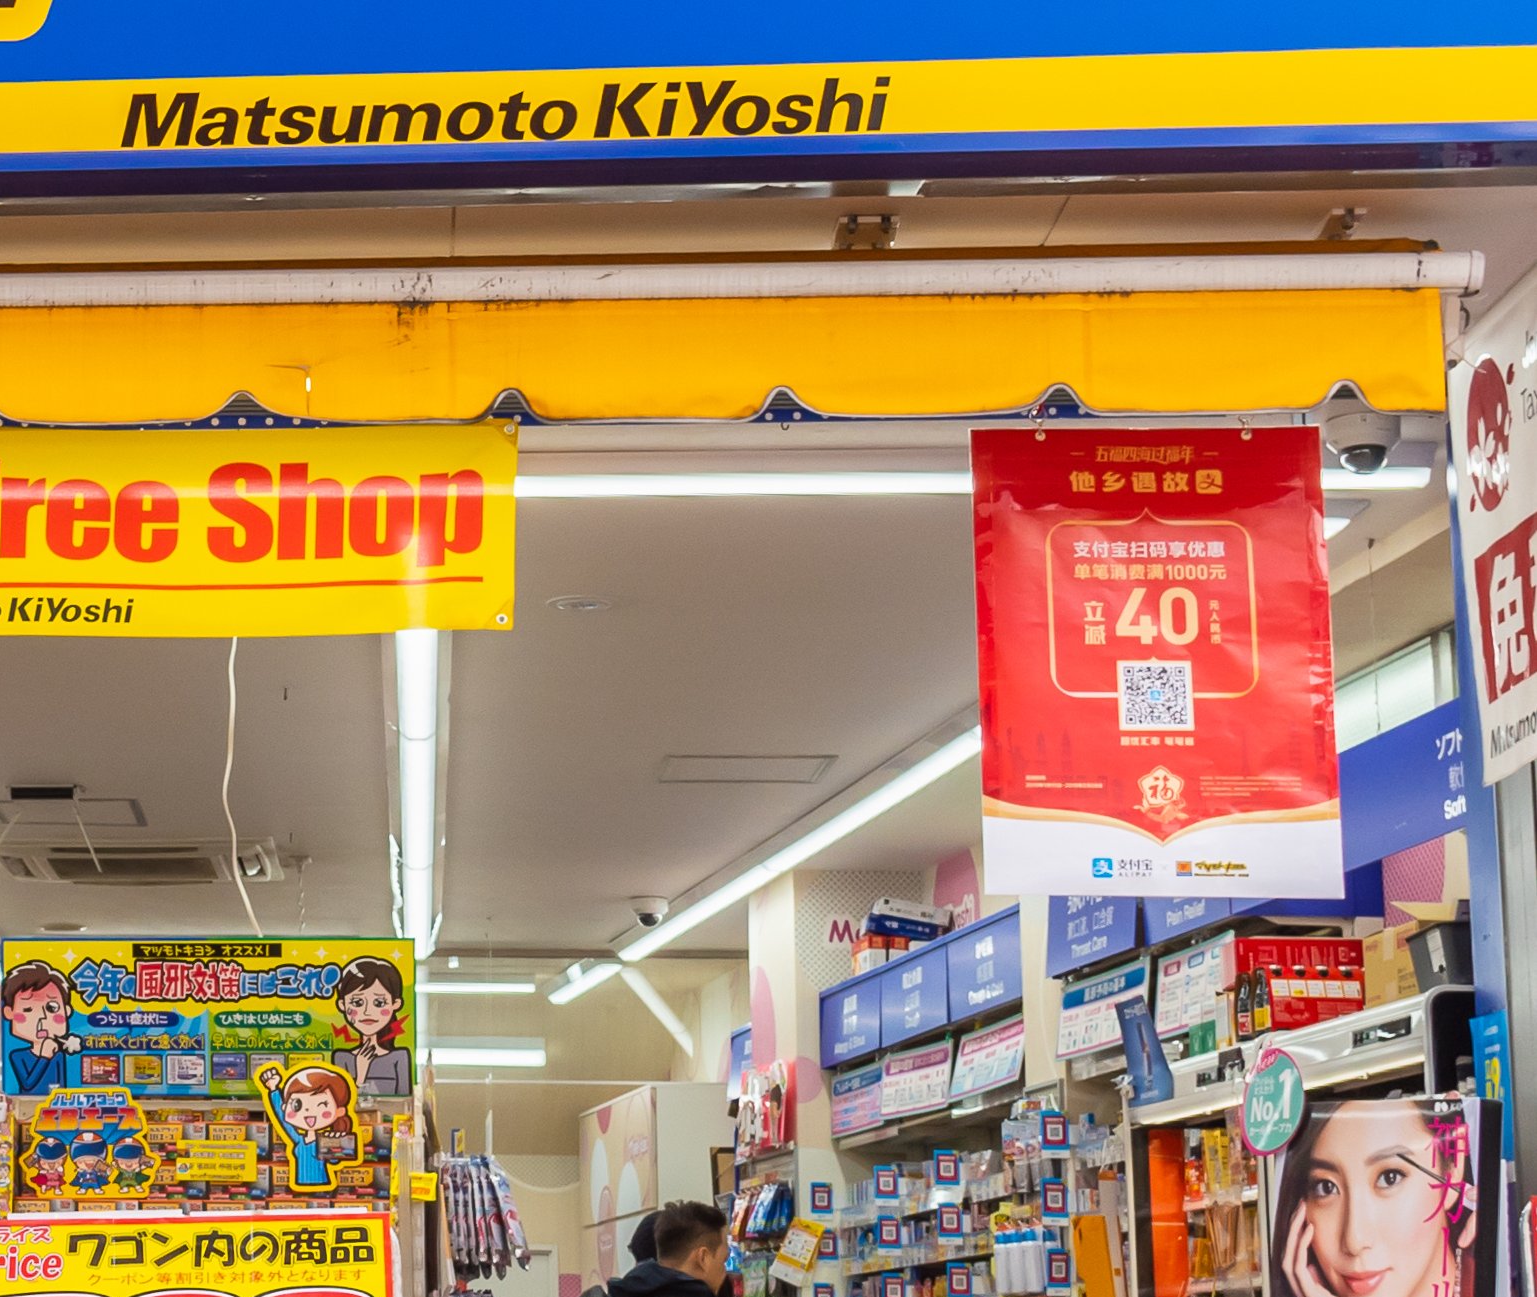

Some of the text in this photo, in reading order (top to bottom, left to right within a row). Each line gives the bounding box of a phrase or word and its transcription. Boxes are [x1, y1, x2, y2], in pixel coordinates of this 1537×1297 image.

[120, 76, 891, 150] Matsumoto KiYoshi
[206, 461, 485, 566] Shop
[1073, 541, 1225, 558] 支付宝扫码享优惠
[1074, 564, 1227, 580] 单笔消费满1000元
[8, 595, 133, 626] KiYoshi
[1115, 586, 1200, 645] 40
[1118, 859, 1153, 871] 支付宝
[140, 945, 215, 956] マツモトキヨシ
[95, 1014, 169, 1025] つらい症状に
[219, 1013, 304, 1026] ひきはじめにも
[68, 1227, 376, 1269] ワゴン内の商品
[87, 1269, 367, 1285] クーポン等割引き対象外となります
